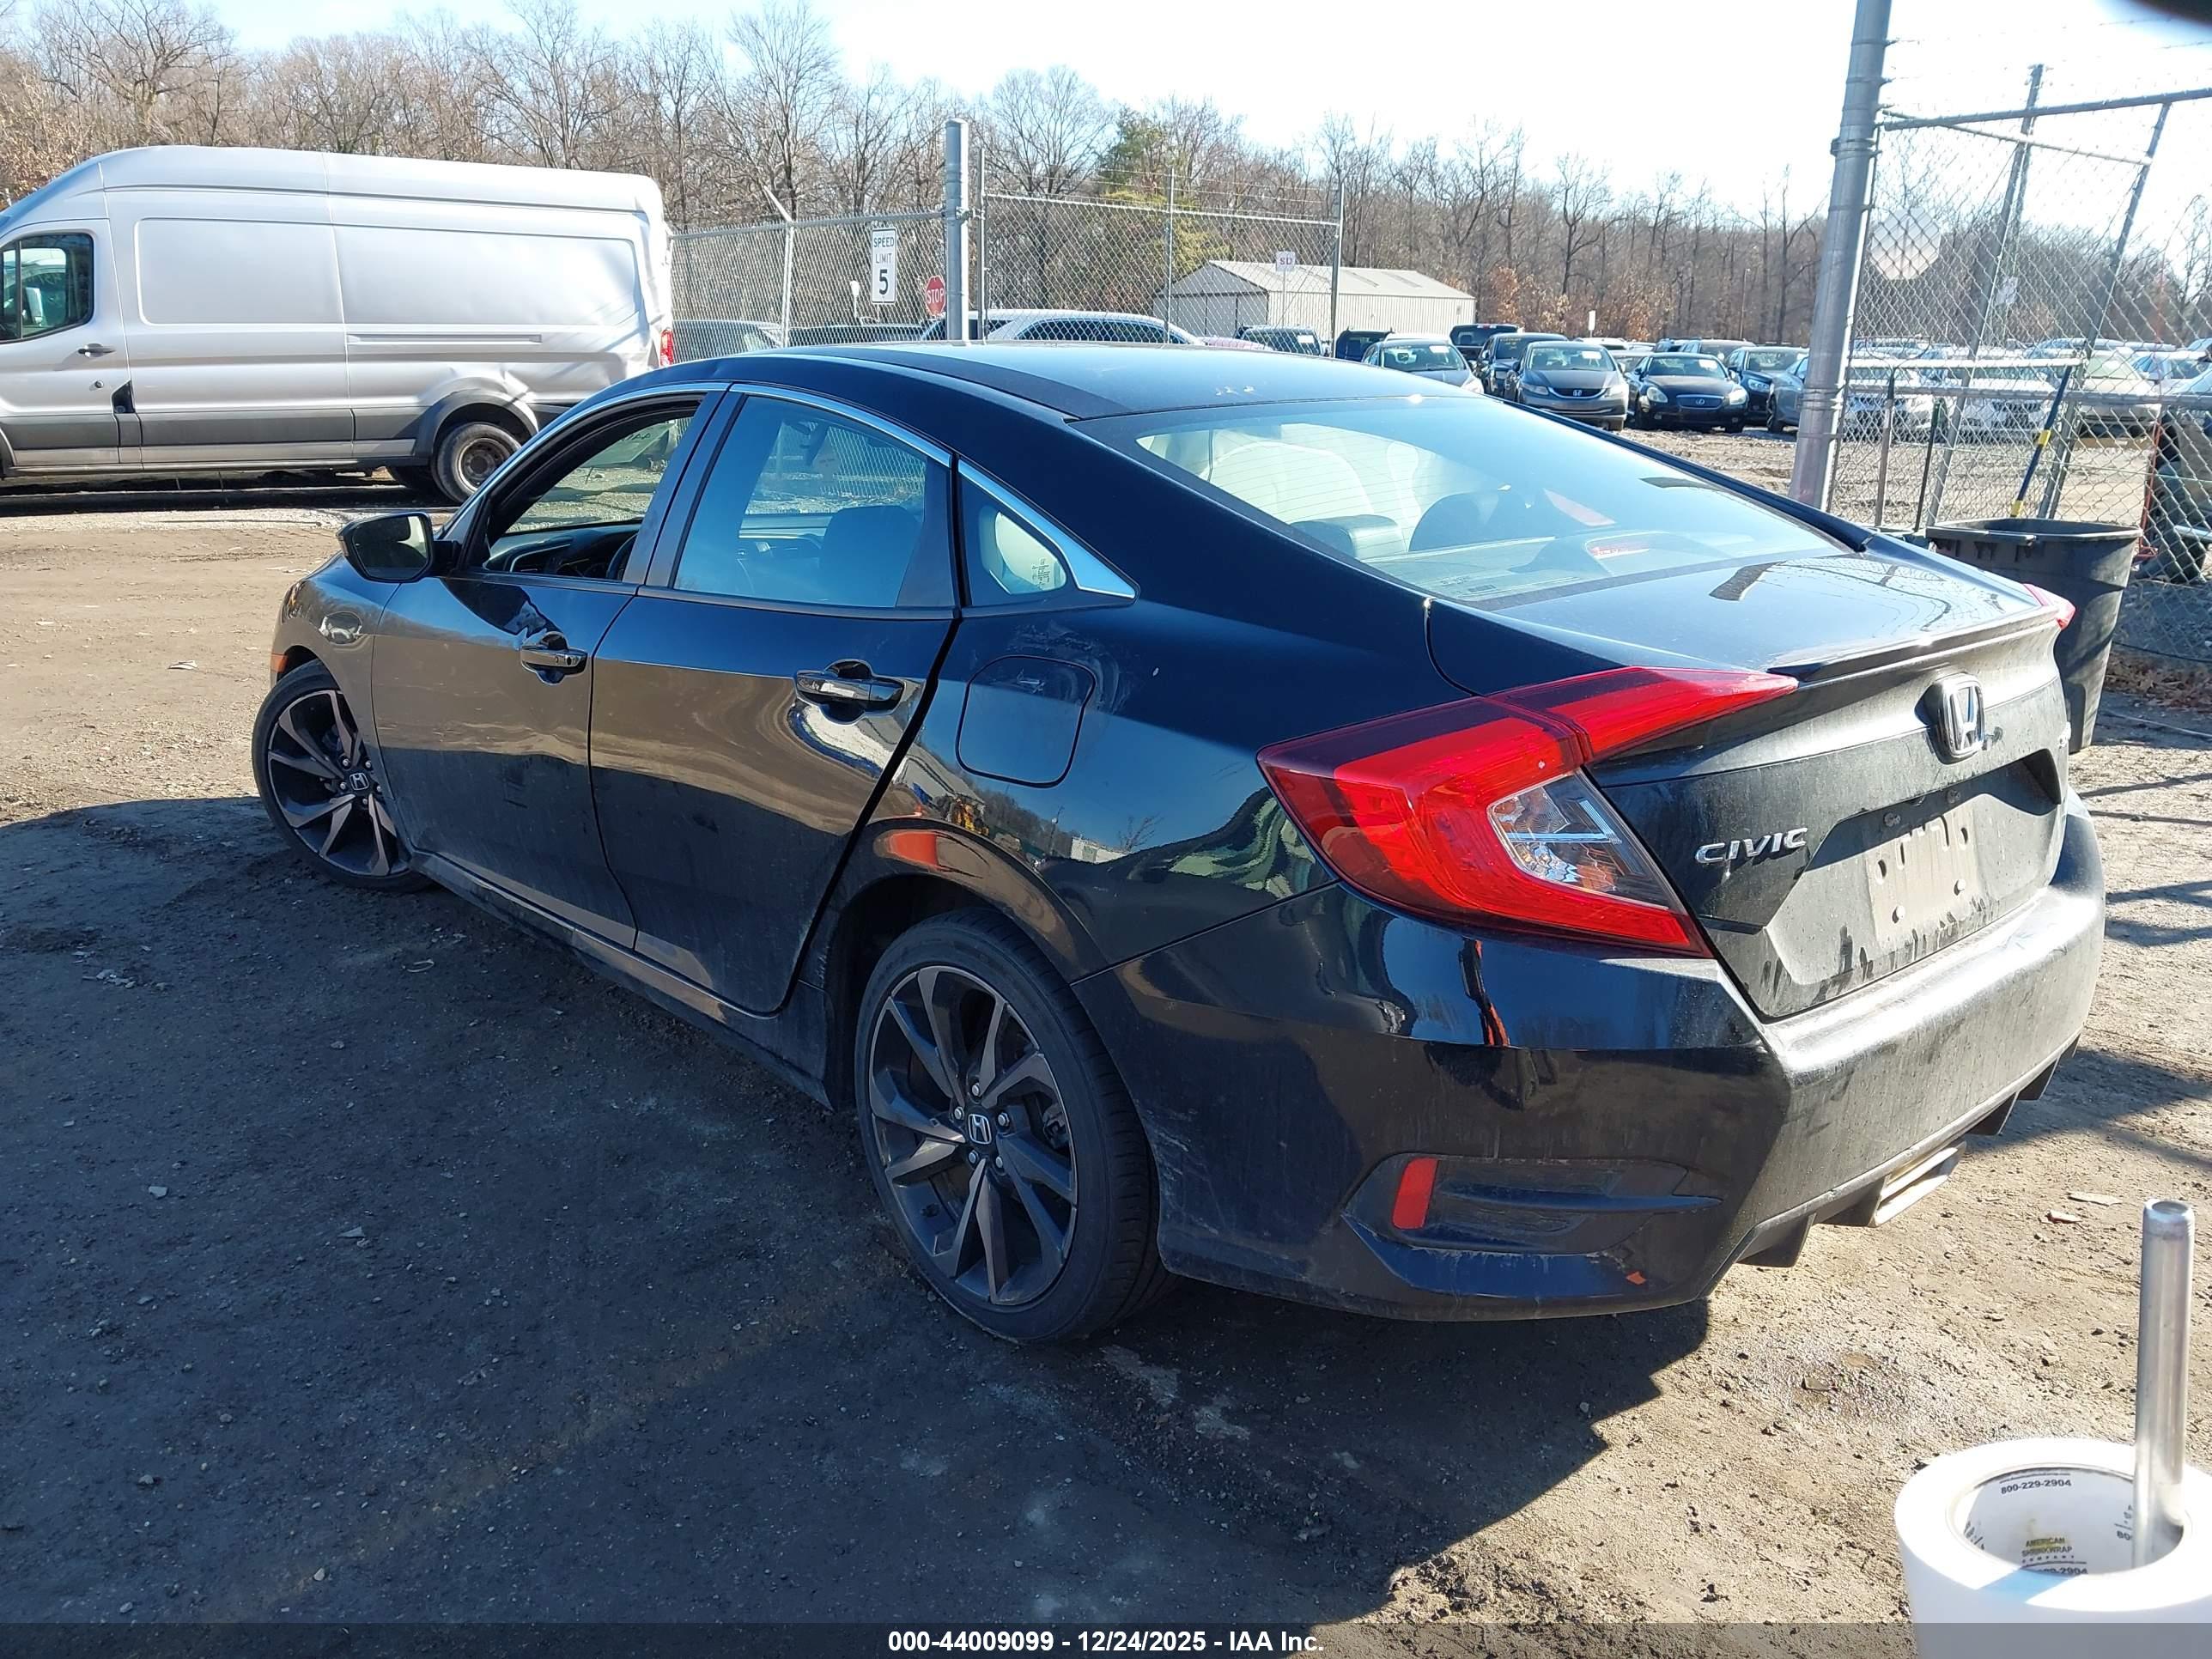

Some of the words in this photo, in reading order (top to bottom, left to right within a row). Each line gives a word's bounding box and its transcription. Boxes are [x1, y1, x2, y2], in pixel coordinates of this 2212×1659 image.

[873, 236, 895, 247] SPEED
[875, 252, 892, 264] LIMIT
[878, 269, 889, 295] 5
[927, 289, 945, 304] STOP
[1695, 827, 1808, 864] CIVIC
[2001, 1479, 2072, 1495] 800-229-2904
